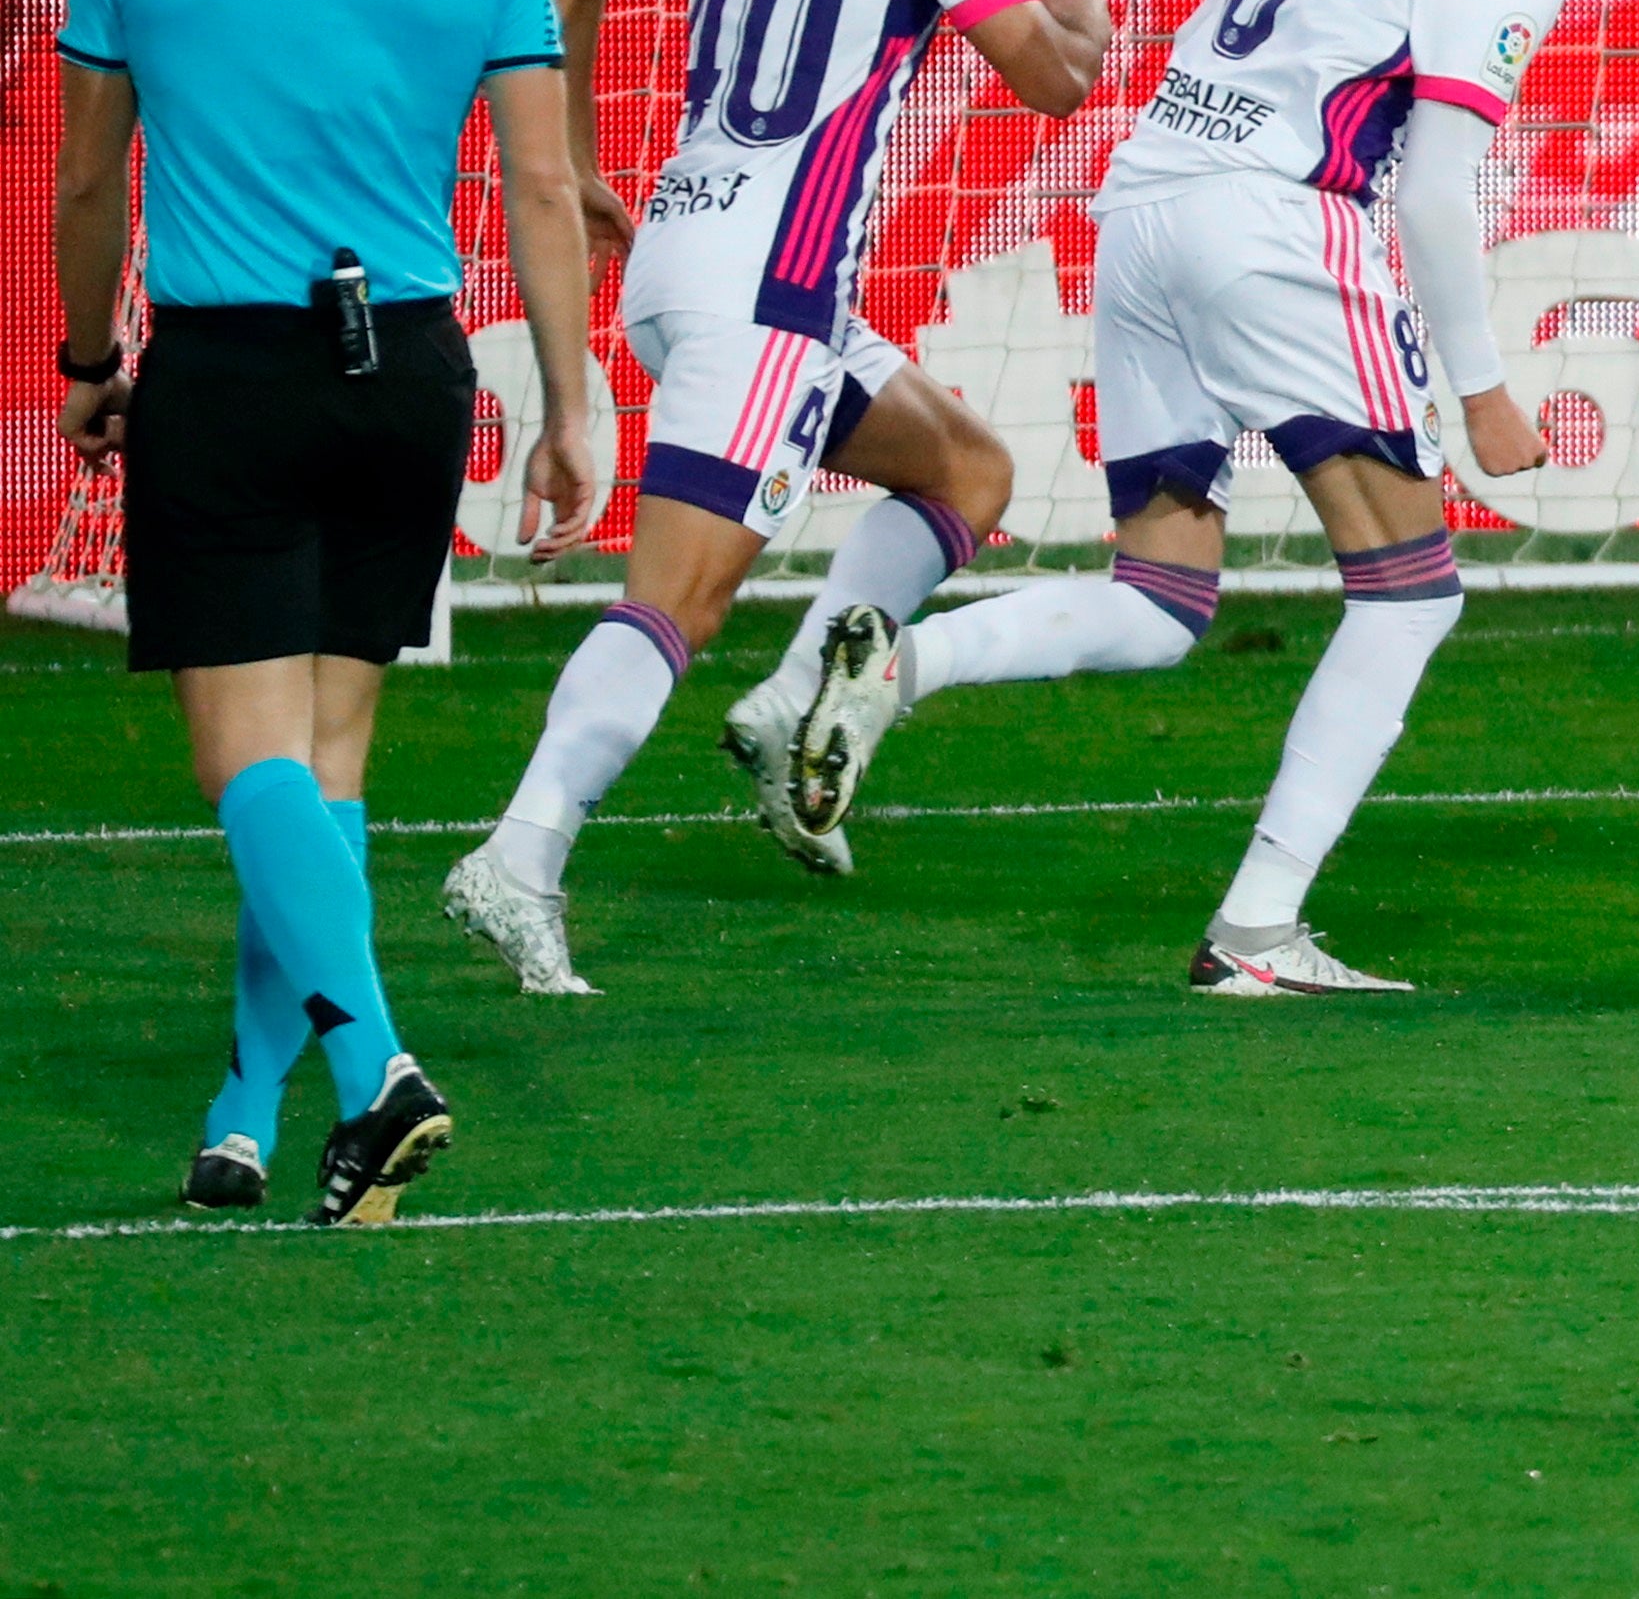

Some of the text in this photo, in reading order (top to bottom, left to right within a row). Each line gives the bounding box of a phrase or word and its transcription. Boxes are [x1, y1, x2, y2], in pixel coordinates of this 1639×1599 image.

[1148, 95, 1255, 143] TRITION
[1164, 67, 1275, 127] RBALIFE
[1392, 309, 1428, 389] 8
[784, 387, 826, 468] 4
